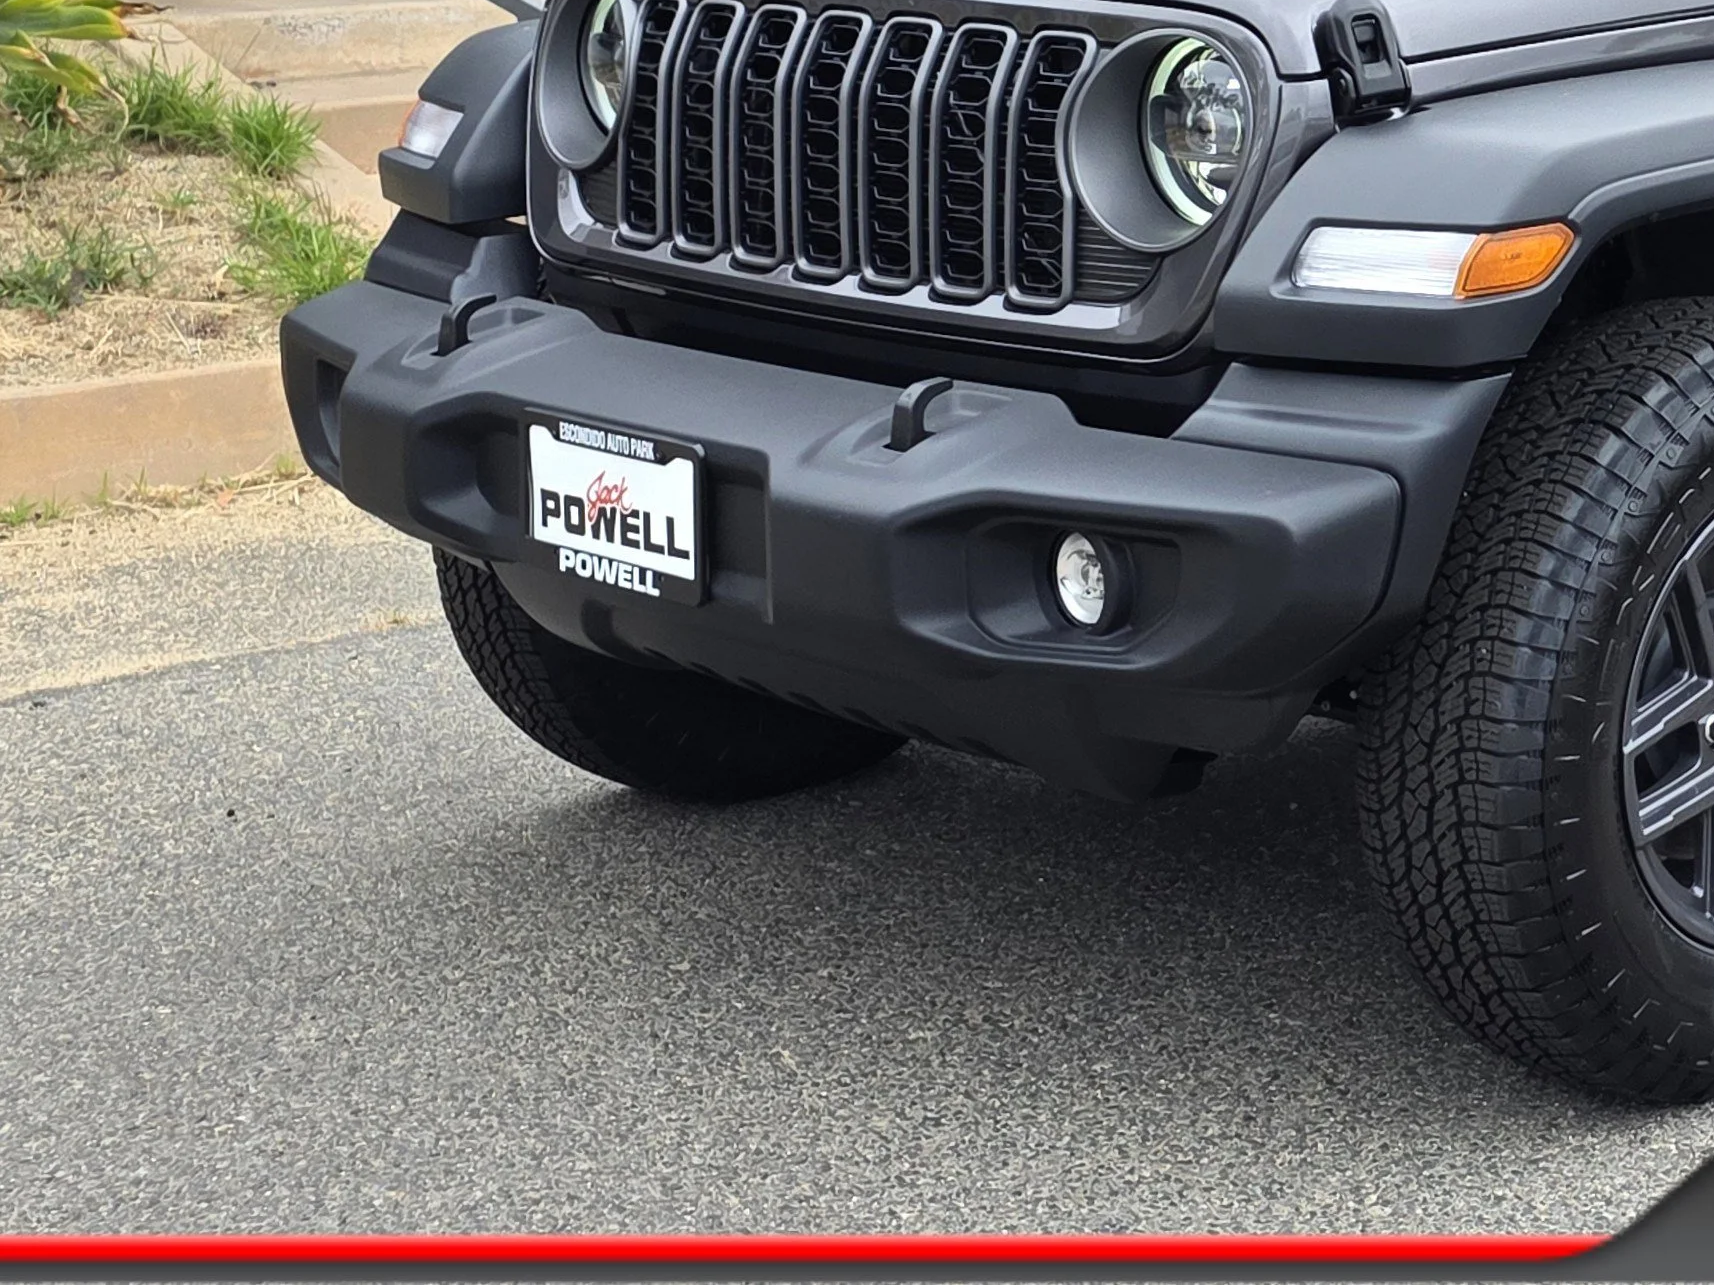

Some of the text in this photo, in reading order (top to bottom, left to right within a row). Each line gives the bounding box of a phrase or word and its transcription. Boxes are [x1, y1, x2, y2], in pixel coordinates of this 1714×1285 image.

[559, 421, 655, 460] ESCONDIDO AUTO PARK
[586, 470, 634, 523] Jack
[540, 488, 690, 560] POWELL
[558, 547, 661, 597] POWELL
